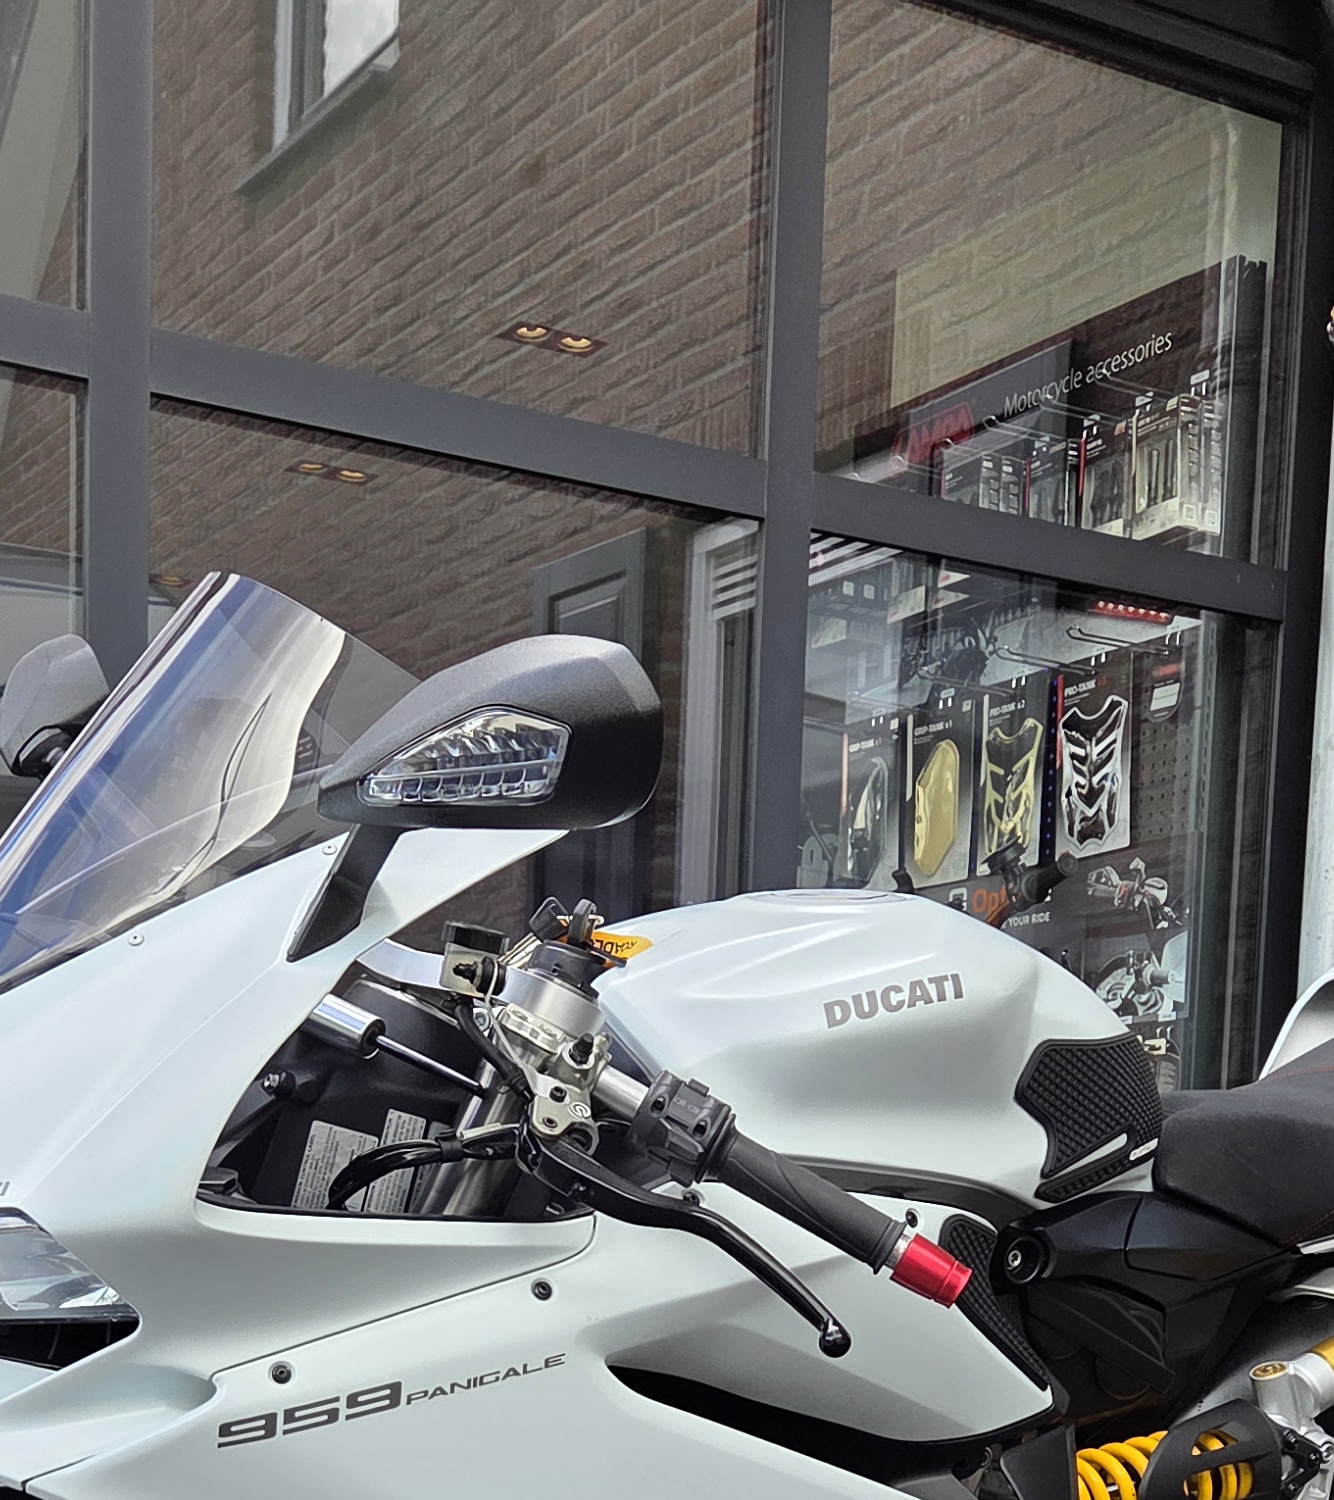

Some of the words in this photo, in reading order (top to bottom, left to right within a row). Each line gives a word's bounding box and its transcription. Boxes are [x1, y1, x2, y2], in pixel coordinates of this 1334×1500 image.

[1003, 367, 1083, 418] Motorcycle
[1085, 331, 1173, 384] accessories
[1031, 911, 1051, 925] RIDE
[822, 972, 964, 1030] DUCATI
[217, 1380, 403, 1449] 959
[405, 1352, 566, 1406] PANIGALE
